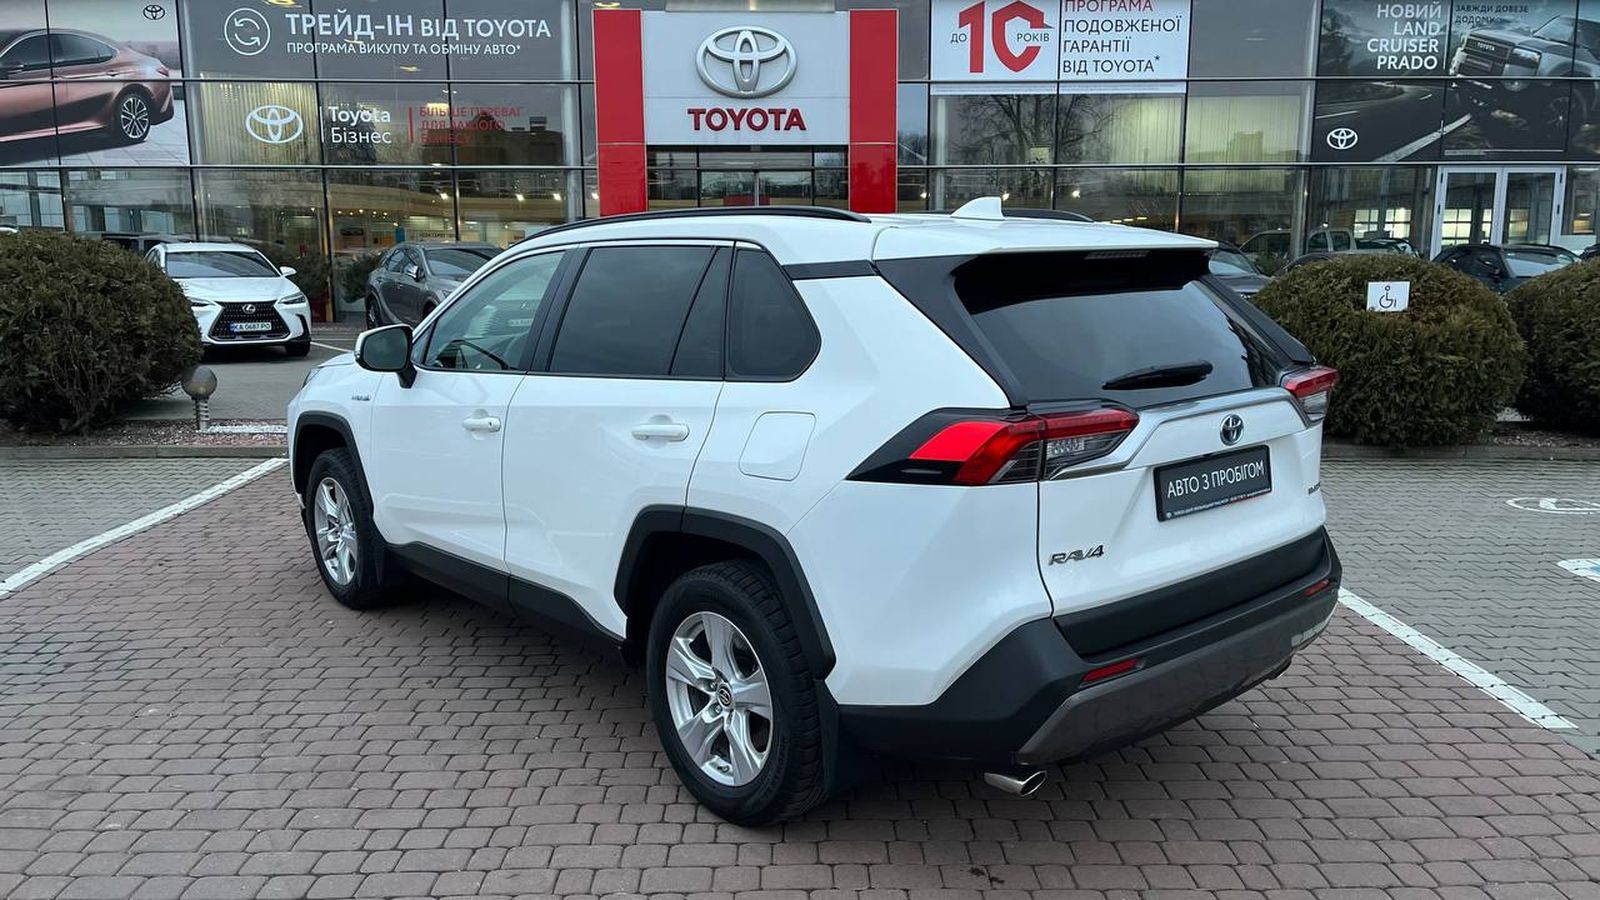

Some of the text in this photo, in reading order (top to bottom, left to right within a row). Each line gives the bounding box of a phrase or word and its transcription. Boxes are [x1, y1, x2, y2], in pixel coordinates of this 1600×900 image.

[1065, 0, 1153, 13] ПРОГРАМА
[1377, 1, 1441, 19] НОВИЙ
[1455, 4, 1529, 13] ЗАВЖДИ ДОВЕЗЕ
[285, 9, 551, 41] ТРЕЙД-ІН ВІД TOYOTA
[1064, 15, 1182, 34] ПОДОВЖЕНОЇ
[1393, 21, 1441, 36] LAND
[950, 33, 968, 43] ДО
[1016, 33, 1050, 42] РОКІВ
[1063, 36, 1131, 53] ГАРАНТІЇ
[1367, 38, 1439, 53] CRUISER
[287, 42, 356, 54] ПРОГРАМА
[359, 43, 409, 55] ВИКУПУ
[412, 44, 428, 54] ТА
[432, 44, 480, 55] ОБМІНУ
[1063, 60, 1088, 76] ВІД
[1376, 55, 1438, 70] PRADO
[328, 106, 391, 127] Toyota
[687, 108, 807, 131] TOYOTA
[331, 127, 392, 144] Бізнес
[1167, 475, 1200, 499] АВТО
[1212, 459, 1265, 486] ПРОБІГОМ
[1049, 544, 1105, 566] RAV4
